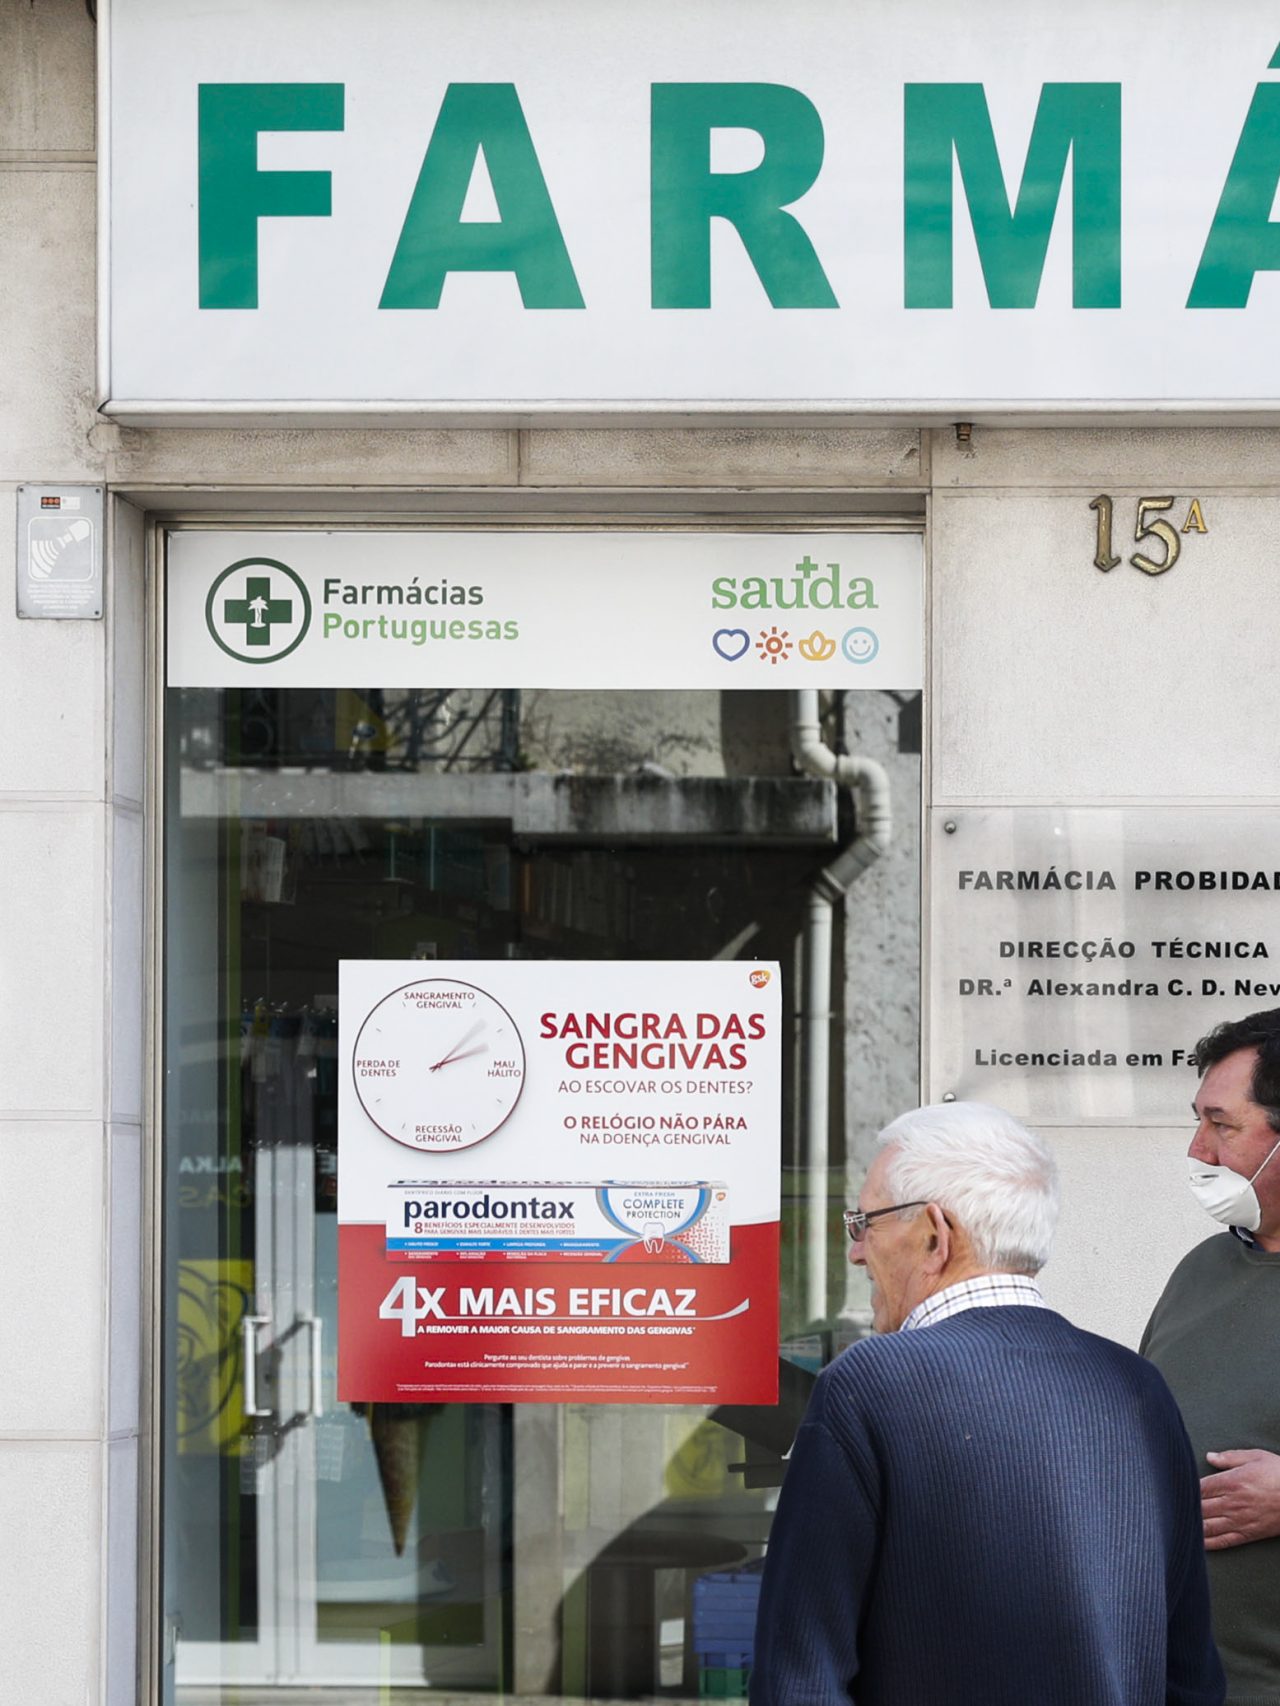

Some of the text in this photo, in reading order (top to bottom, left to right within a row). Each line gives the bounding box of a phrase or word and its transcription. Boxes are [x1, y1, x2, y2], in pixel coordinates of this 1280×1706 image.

[324, 577, 483, 605] Farmácias
[324, 614, 518, 646] Portuguesas
[959, 866, 1116, 890] FARMÁCIA
[1000, 937, 1268, 962] DIRECÇÃO TÉCNICA
[751, 974, 768, 987] gsk
[1028, 979, 1159, 996] Alexandra
[1168, 979, 1192, 996] C.
[1202, 980, 1225, 995] D.
[404, 991, 475, 1001] SANGRAMENTO
[416, 1000, 463, 1010] GENGIVAL
[540, 1013, 765, 1040] SANGRA DAS
[566, 1043, 747, 1070] GENGIVAS
[976, 1049, 1199, 1066] Licenciada em Fa
[356, 1059, 400, 1069] PERDA DE
[493, 1060, 516, 1069] MAU
[360, 1068, 397, 1078] DENTES
[487, 1067, 521, 1078] HÁLITO
[558, 1080, 753, 1094] AO ESCOVAR OS DENTES?
[564, 1113, 747, 1129] O RELÓGIO NÃO PÁRA
[415, 1124, 463, 1134] RECESSÃO
[415, 1133, 463, 1143] GENGIVAL
[581, 1133, 731, 1147] NA DOENÇA GENGIVAL
[623, 1198, 685, 1209] COMPLETE
[405, 1195, 574, 1229] parodontax
[626, 1210, 681, 1219] PROTECTION
[415, 1222, 423, 1233] 8
[424, 1221, 575, 1229] BENEFÍCIOS ESPECIALMENTE DESENVOLVIDOS
[379, 1276, 696, 1337] 4X MAIS EFICAZ
[417, 1325, 425, 1335] A
[426, 1325, 469, 1335] REMOVER
[470, 1325, 478, 1335] A
[479, 1325, 510, 1335] MAIOR
[511, 1325, 542, 1335] CAUSA
[543, 1325, 555, 1335] DE
[556, 1325, 625, 1335] SANGRAMENTO
[627, 1325, 646, 1335] DAS
